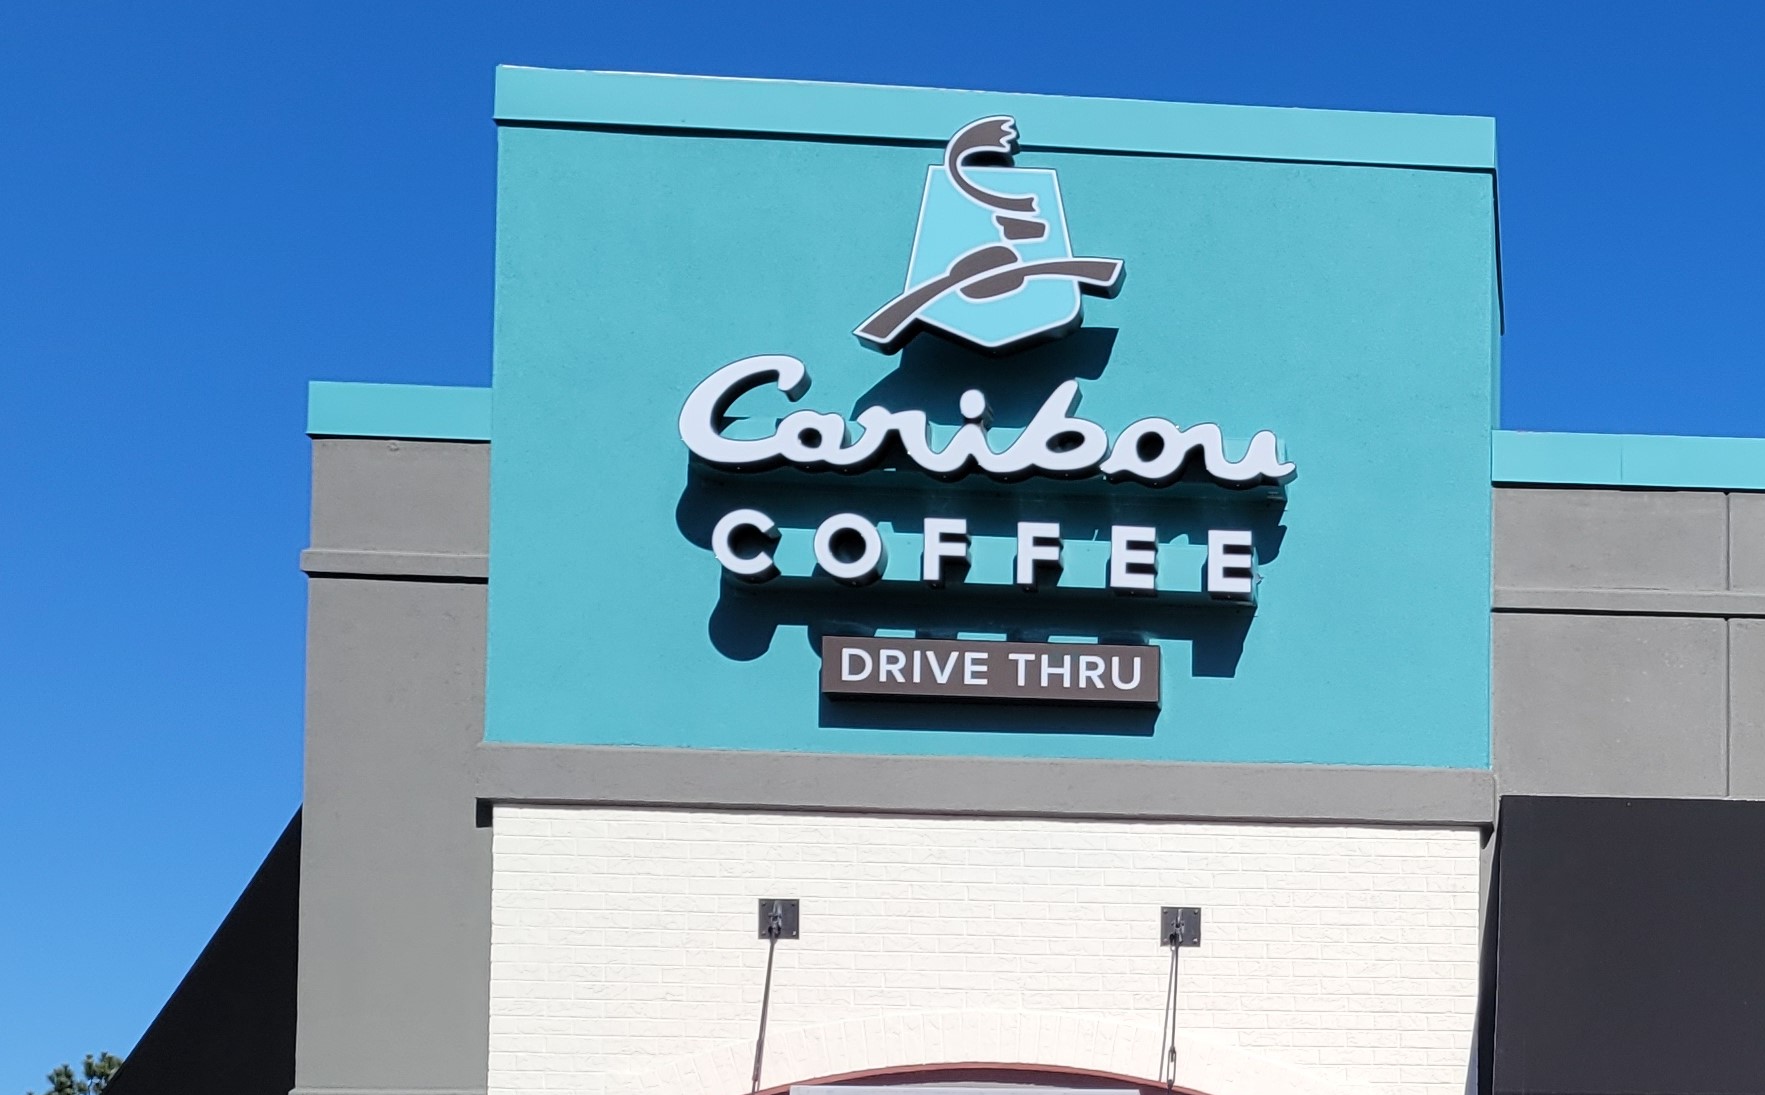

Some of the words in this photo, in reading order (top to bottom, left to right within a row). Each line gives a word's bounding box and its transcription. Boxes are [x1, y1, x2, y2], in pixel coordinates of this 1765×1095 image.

[678, 354, 1296, 484] Caribou
[712, 508, 1254, 594] COFFEE
[841, 647, 989, 686] DRIVE
[1008, 653, 1141, 690] THRU
